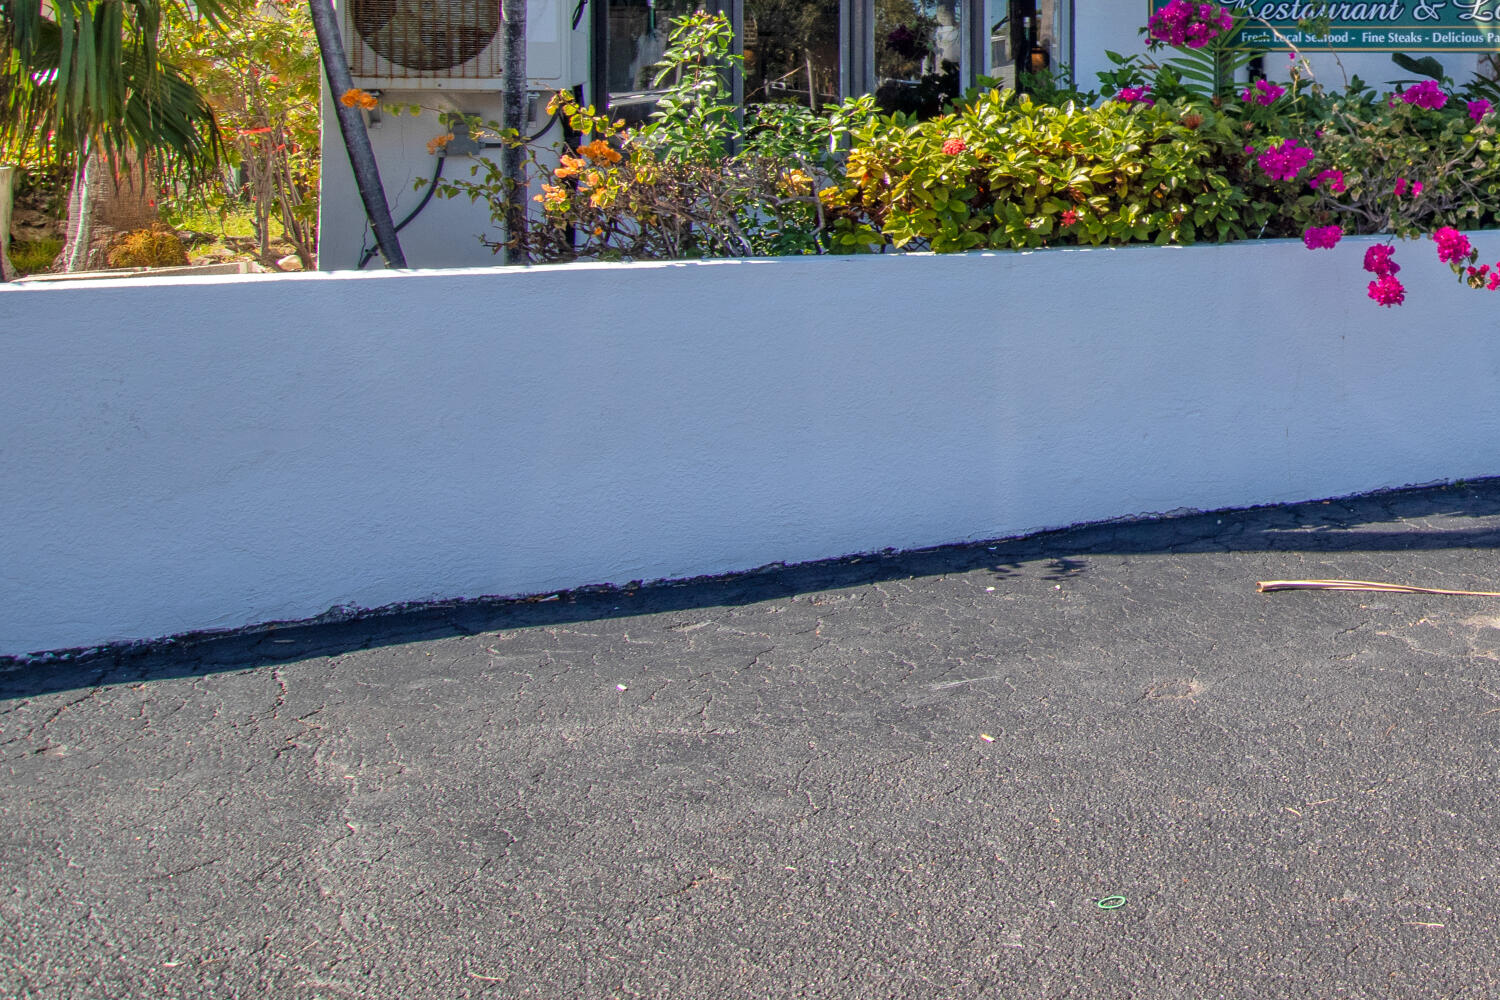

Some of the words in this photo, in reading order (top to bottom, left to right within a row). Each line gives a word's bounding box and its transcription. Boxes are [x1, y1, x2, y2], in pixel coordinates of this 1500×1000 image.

[1361, 31, 1385, 43] Fine
[1388, 31, 1422, 43] Steaks
[1432, 31, 1485, 43] Delicious
